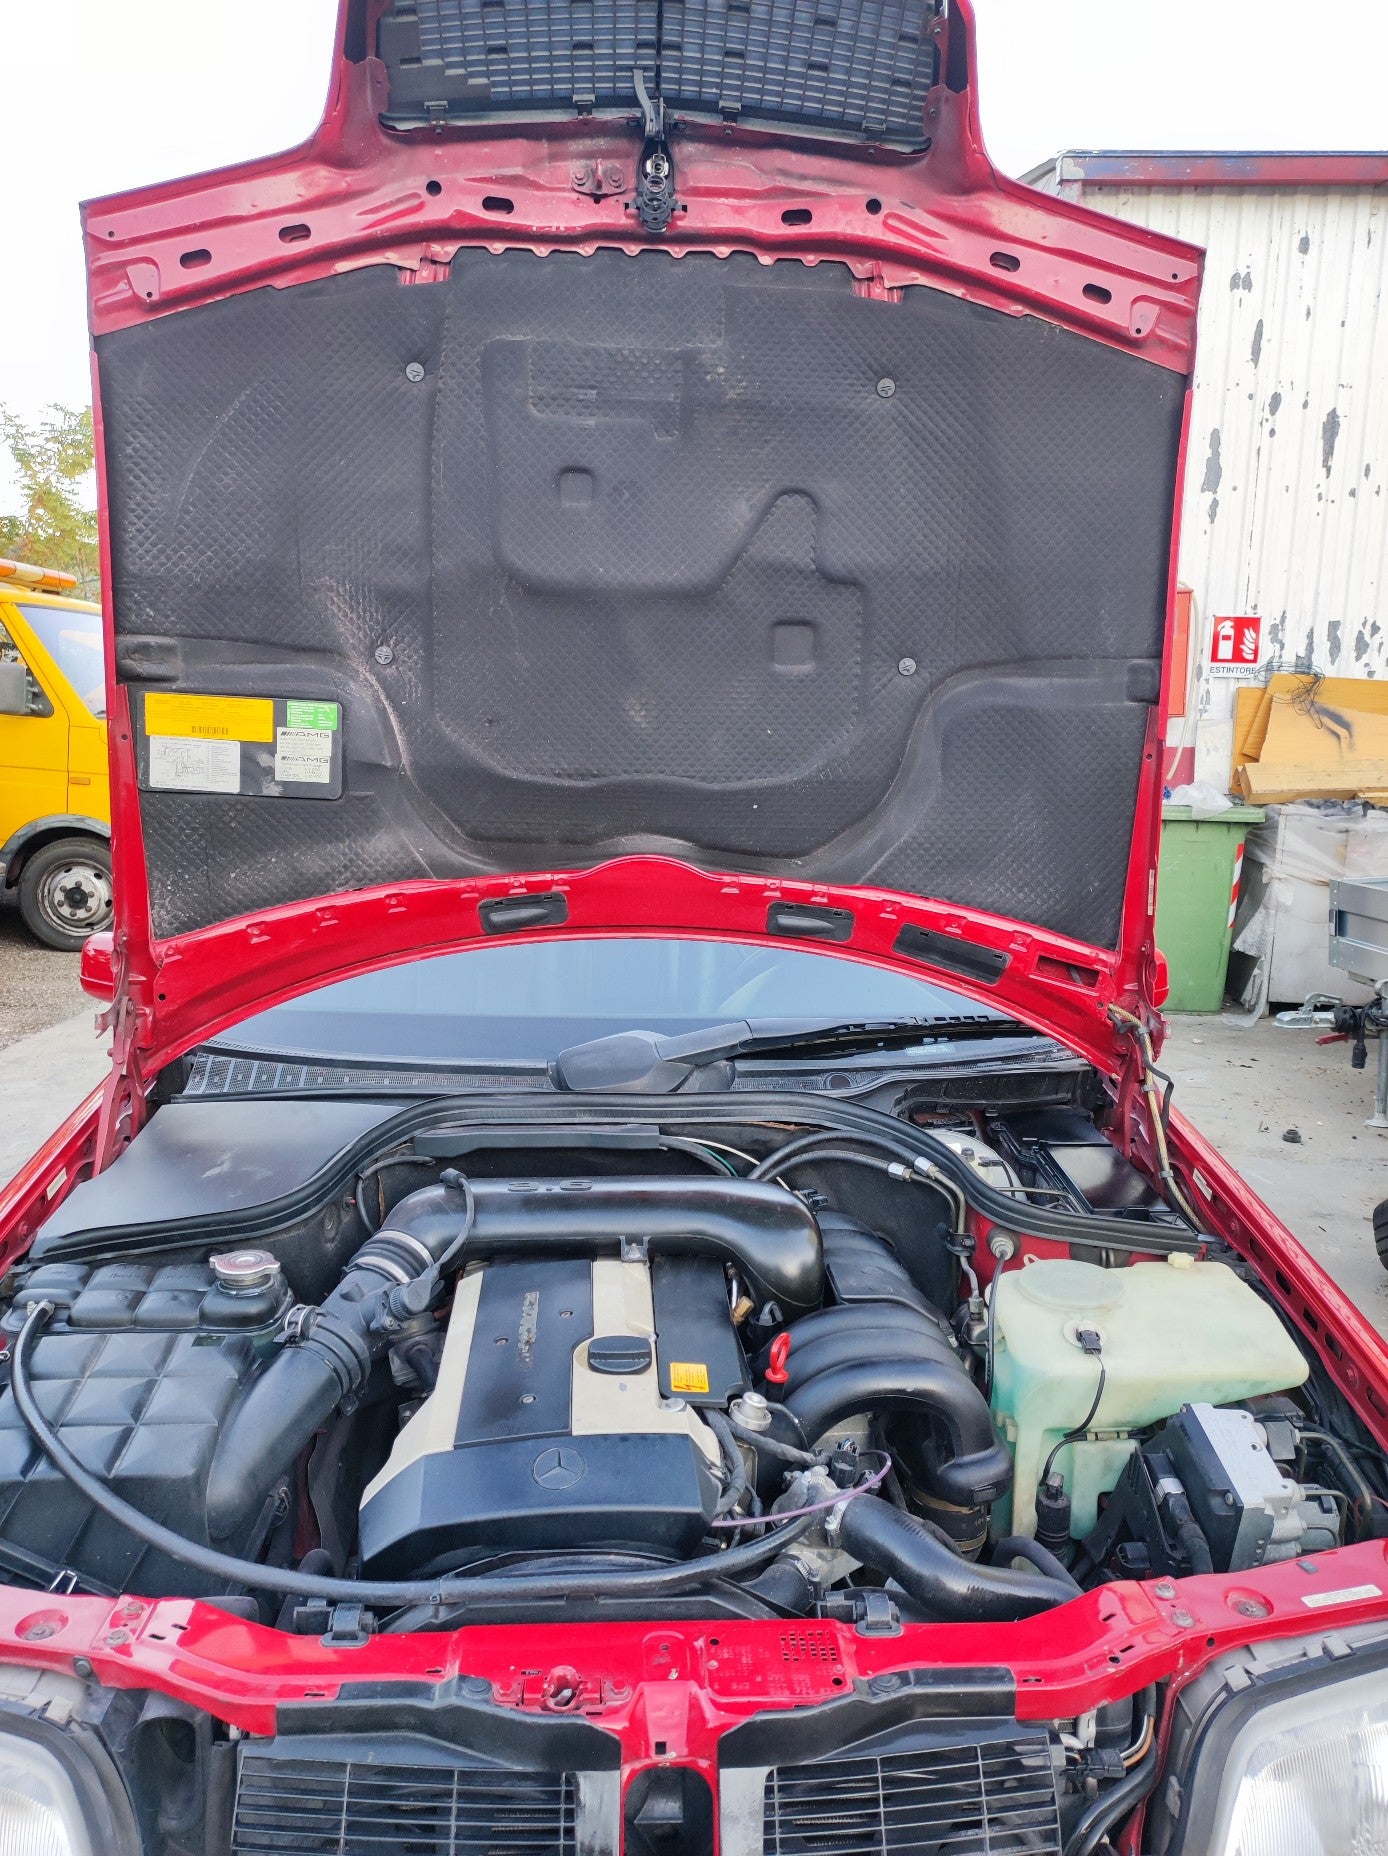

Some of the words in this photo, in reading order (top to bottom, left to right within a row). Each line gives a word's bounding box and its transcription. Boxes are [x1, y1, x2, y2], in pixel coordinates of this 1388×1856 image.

[1209, 666, 1257, 674] ESTINTORE
[295, 731, 330, 739] AMG
[295, 755, 329, 764] AMG
